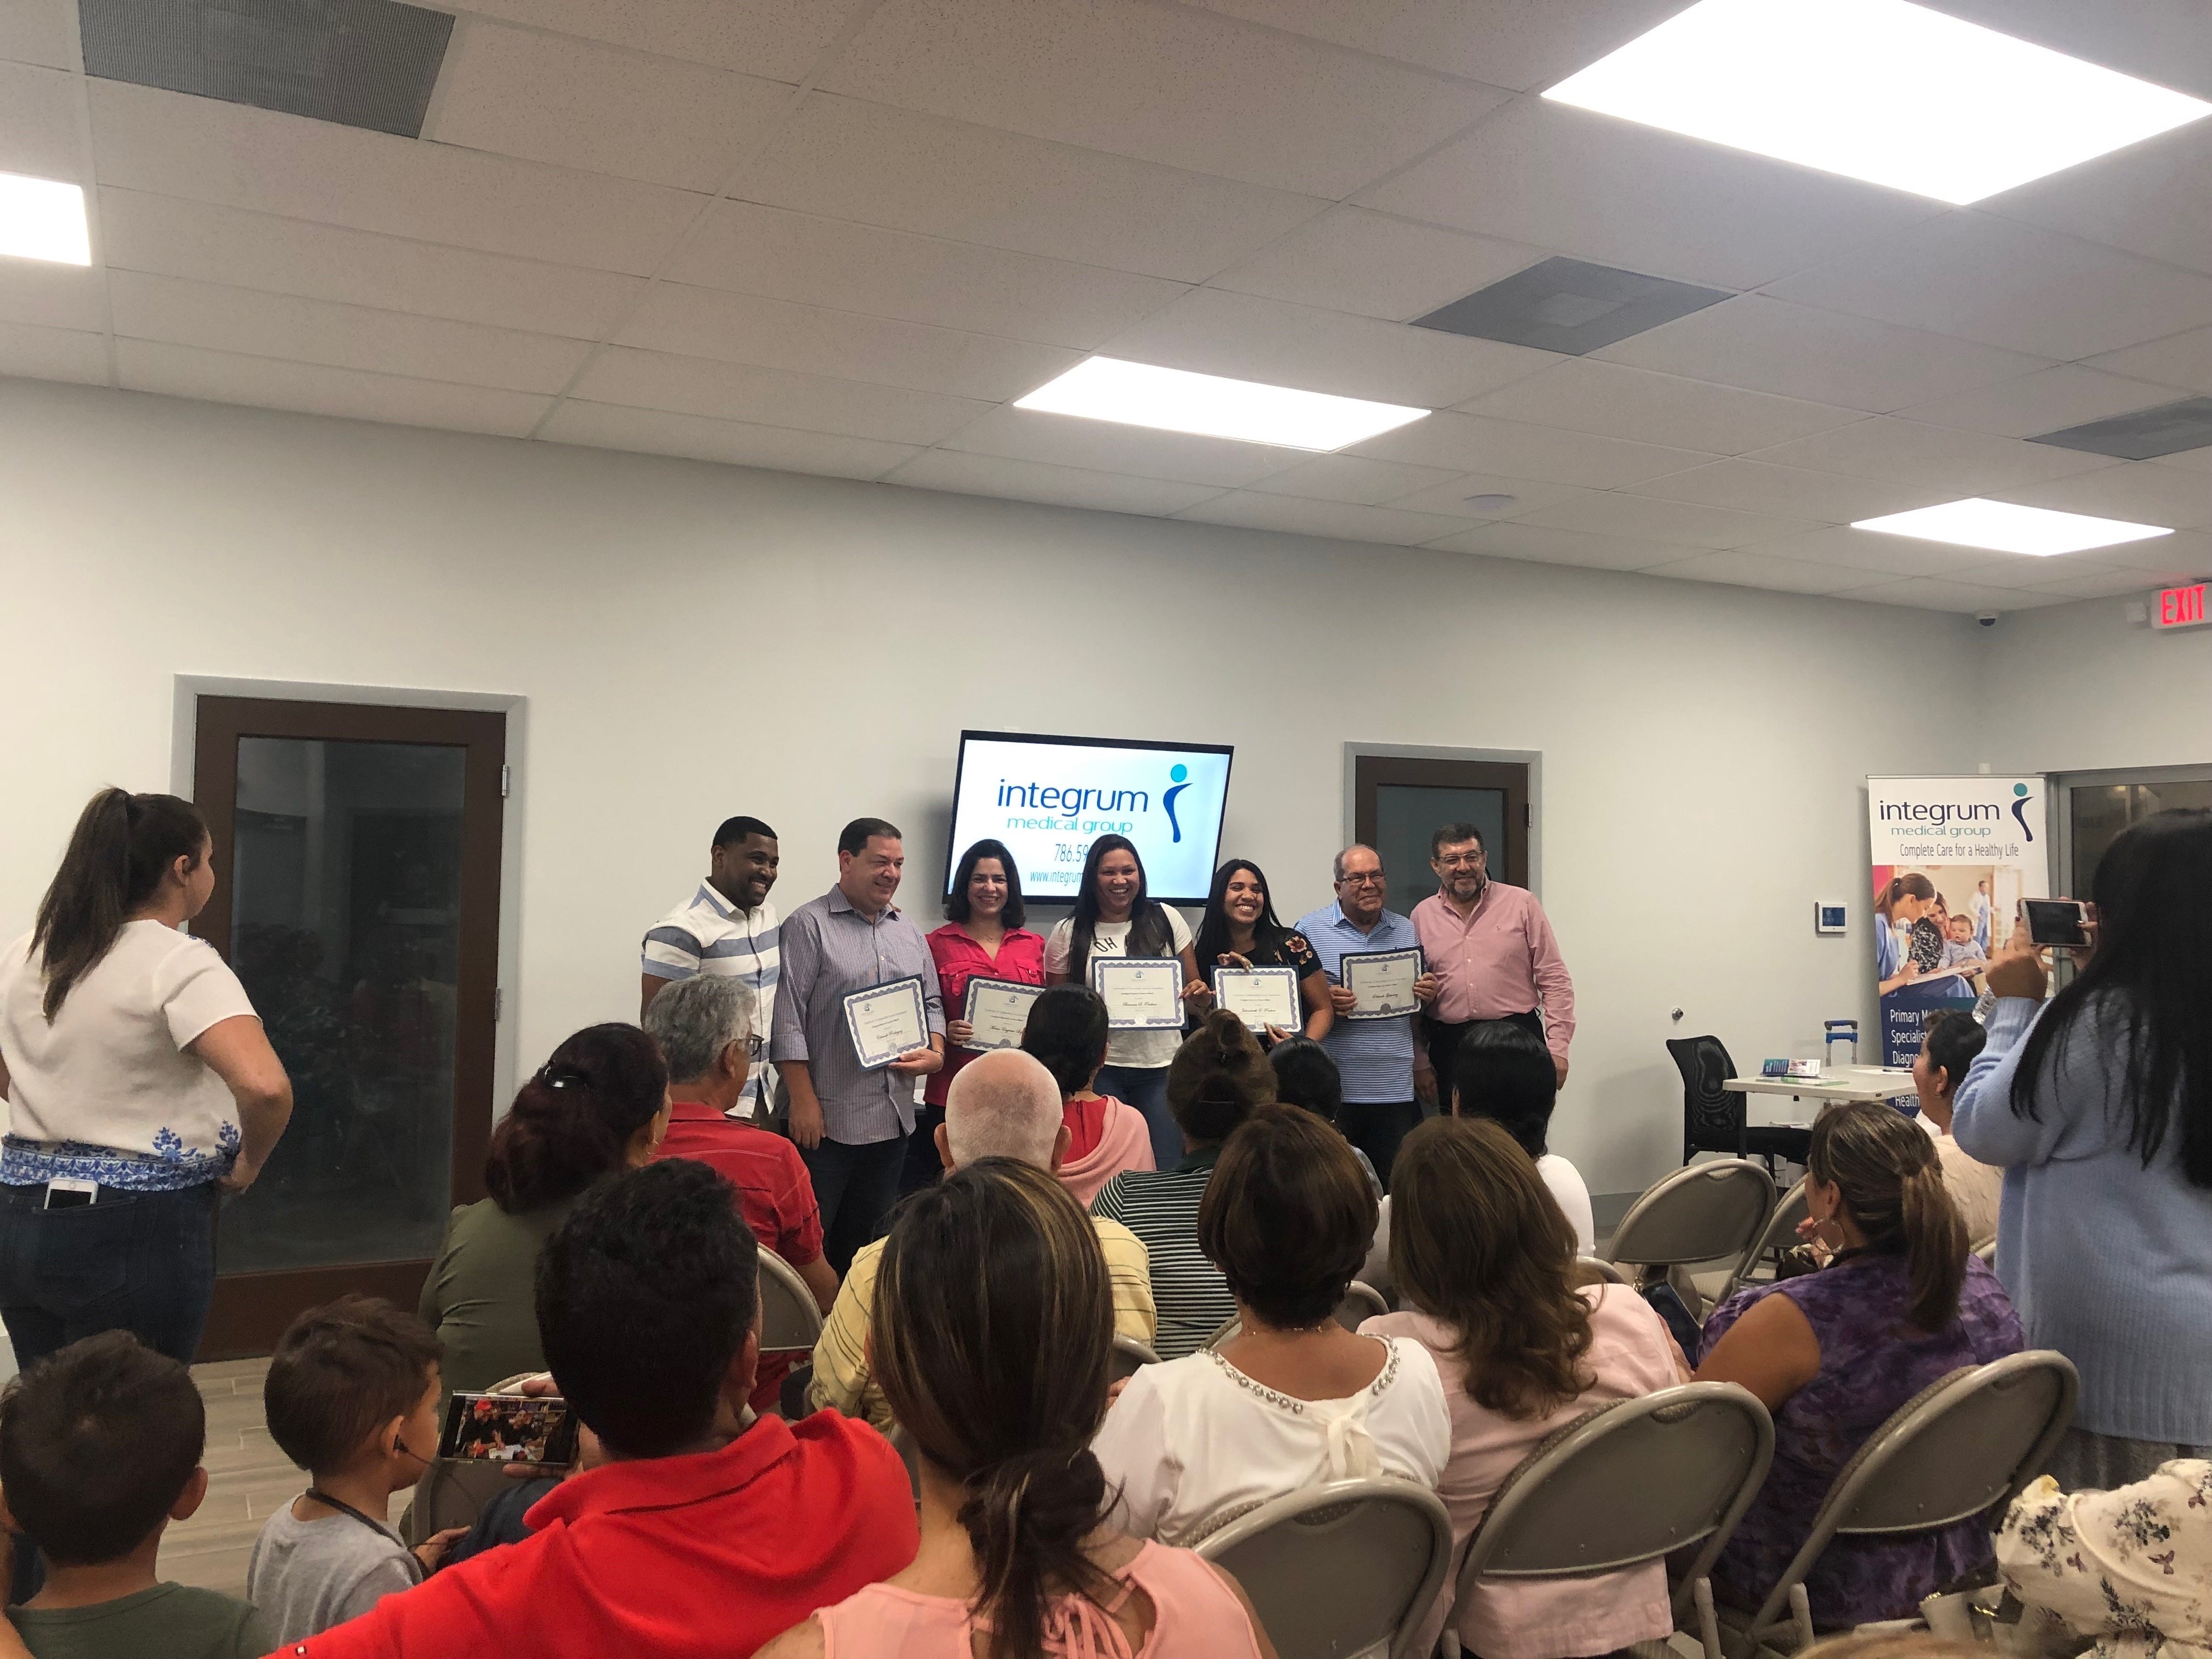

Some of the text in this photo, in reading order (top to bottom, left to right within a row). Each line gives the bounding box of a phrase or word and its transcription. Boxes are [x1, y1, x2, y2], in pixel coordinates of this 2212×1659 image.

[2160, 585, 2206, 625] EXIT
[997, 778, 1149, 817] integrum
[1880, 800, 2000, 826] integrum
[1007, 816, 1133, 836] medical group
[1891, 825, 1991, 838] medical group
[1900, 843, 2019, 859] Complete Care for a Healthy Life
[1890, 1008, 1920, 1026] Primary
